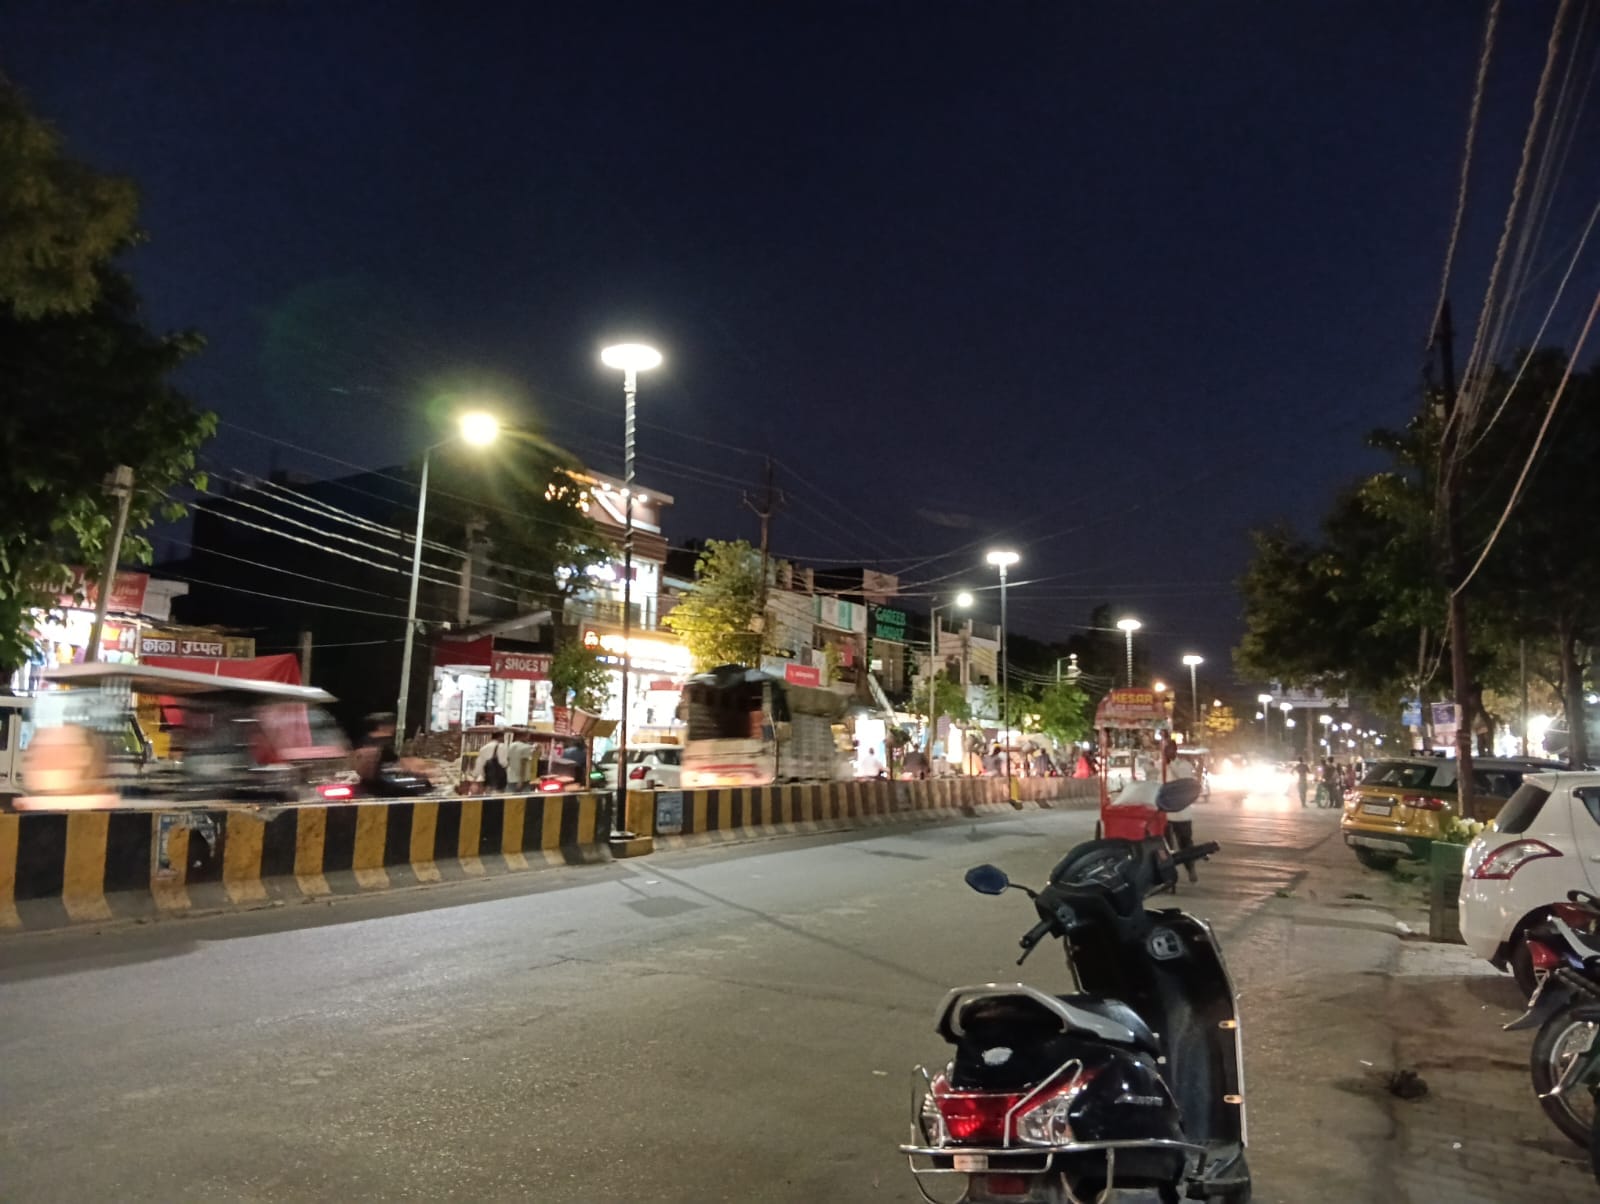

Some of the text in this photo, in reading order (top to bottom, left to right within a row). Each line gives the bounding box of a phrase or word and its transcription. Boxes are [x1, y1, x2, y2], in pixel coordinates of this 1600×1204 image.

[142, 638, 177, 653] काका
[182, 640, 224, 656] उप्पल
[505, 657, 539, 673] SHOES
[1112, 693, 1153, 704] KESAR
